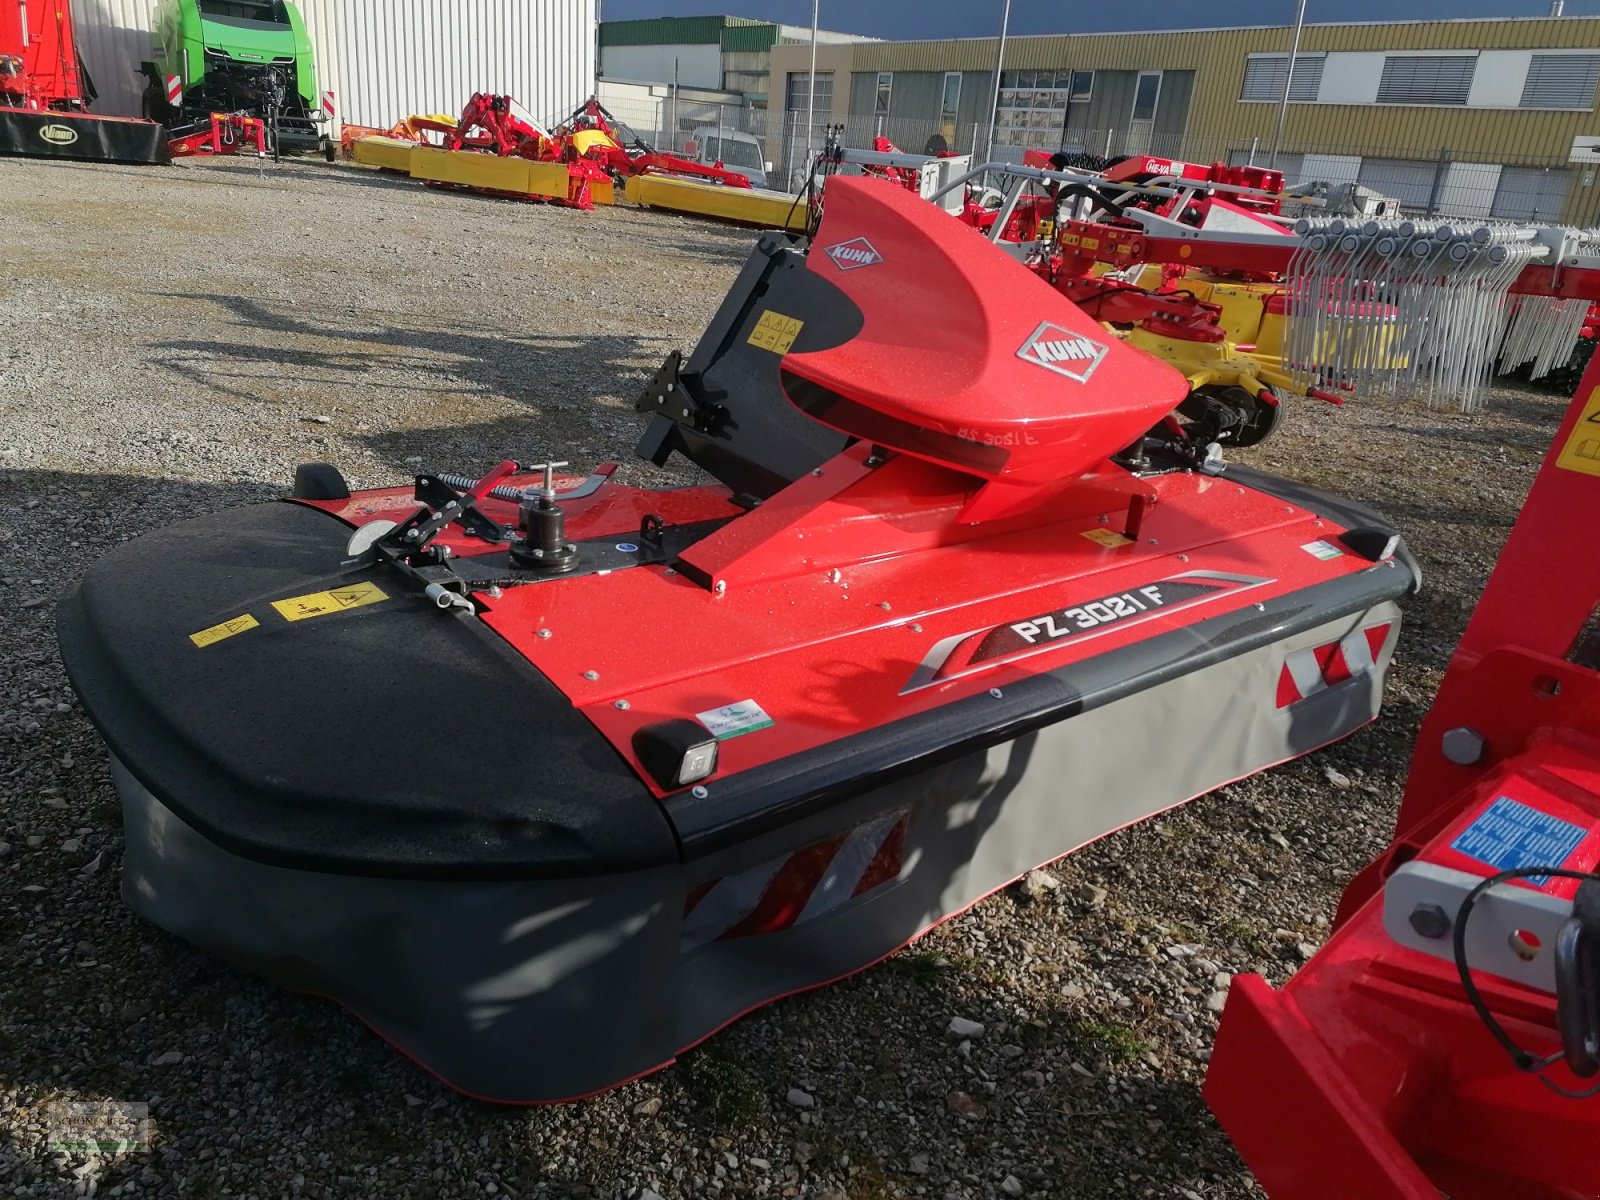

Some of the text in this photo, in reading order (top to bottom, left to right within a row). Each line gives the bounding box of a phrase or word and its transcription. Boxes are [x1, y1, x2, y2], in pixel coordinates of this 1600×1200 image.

[45, 125, 73, 140] Vicon
[1149, 162, 1170, 175] HE-VA
[832, 246, 876, 265] KUHN
[1031, 338, 1099, 362] KUHN
[1010, 585, 1164, 643] PZ 3021 F
